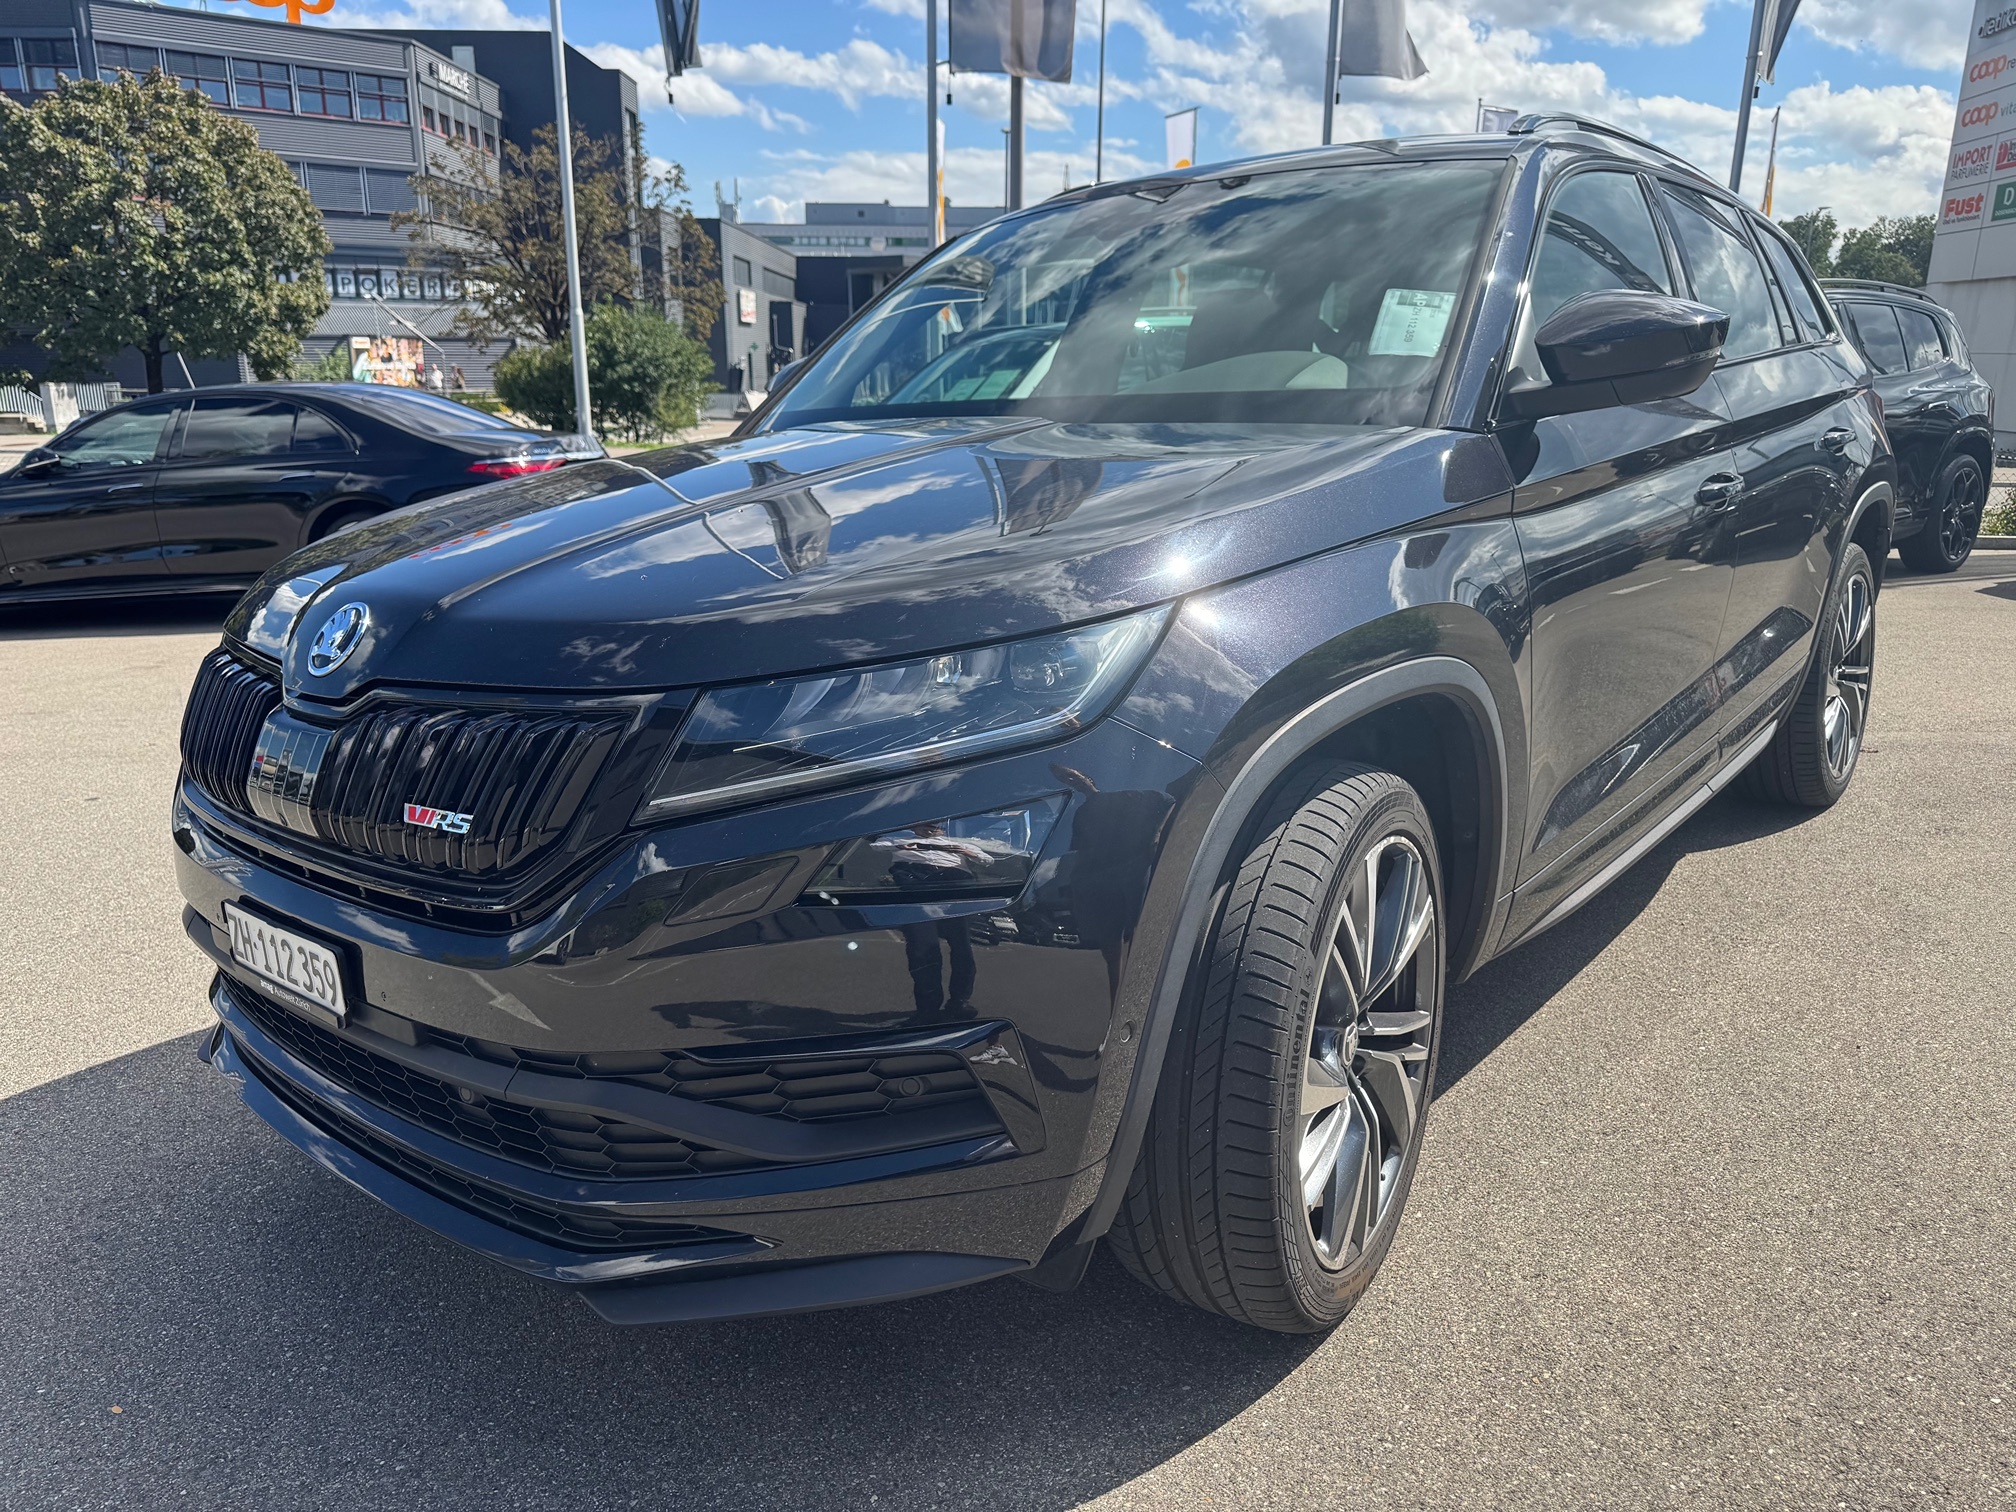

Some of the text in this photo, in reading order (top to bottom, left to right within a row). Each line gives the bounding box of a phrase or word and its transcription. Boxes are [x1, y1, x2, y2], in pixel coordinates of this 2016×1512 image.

[1969, 54, 2007, 82] coop
[1961, 101, 1998, 128] coop
[1952, 144, 1993, 169] IMPORT
[1413, 292, 1428, 307] AP
